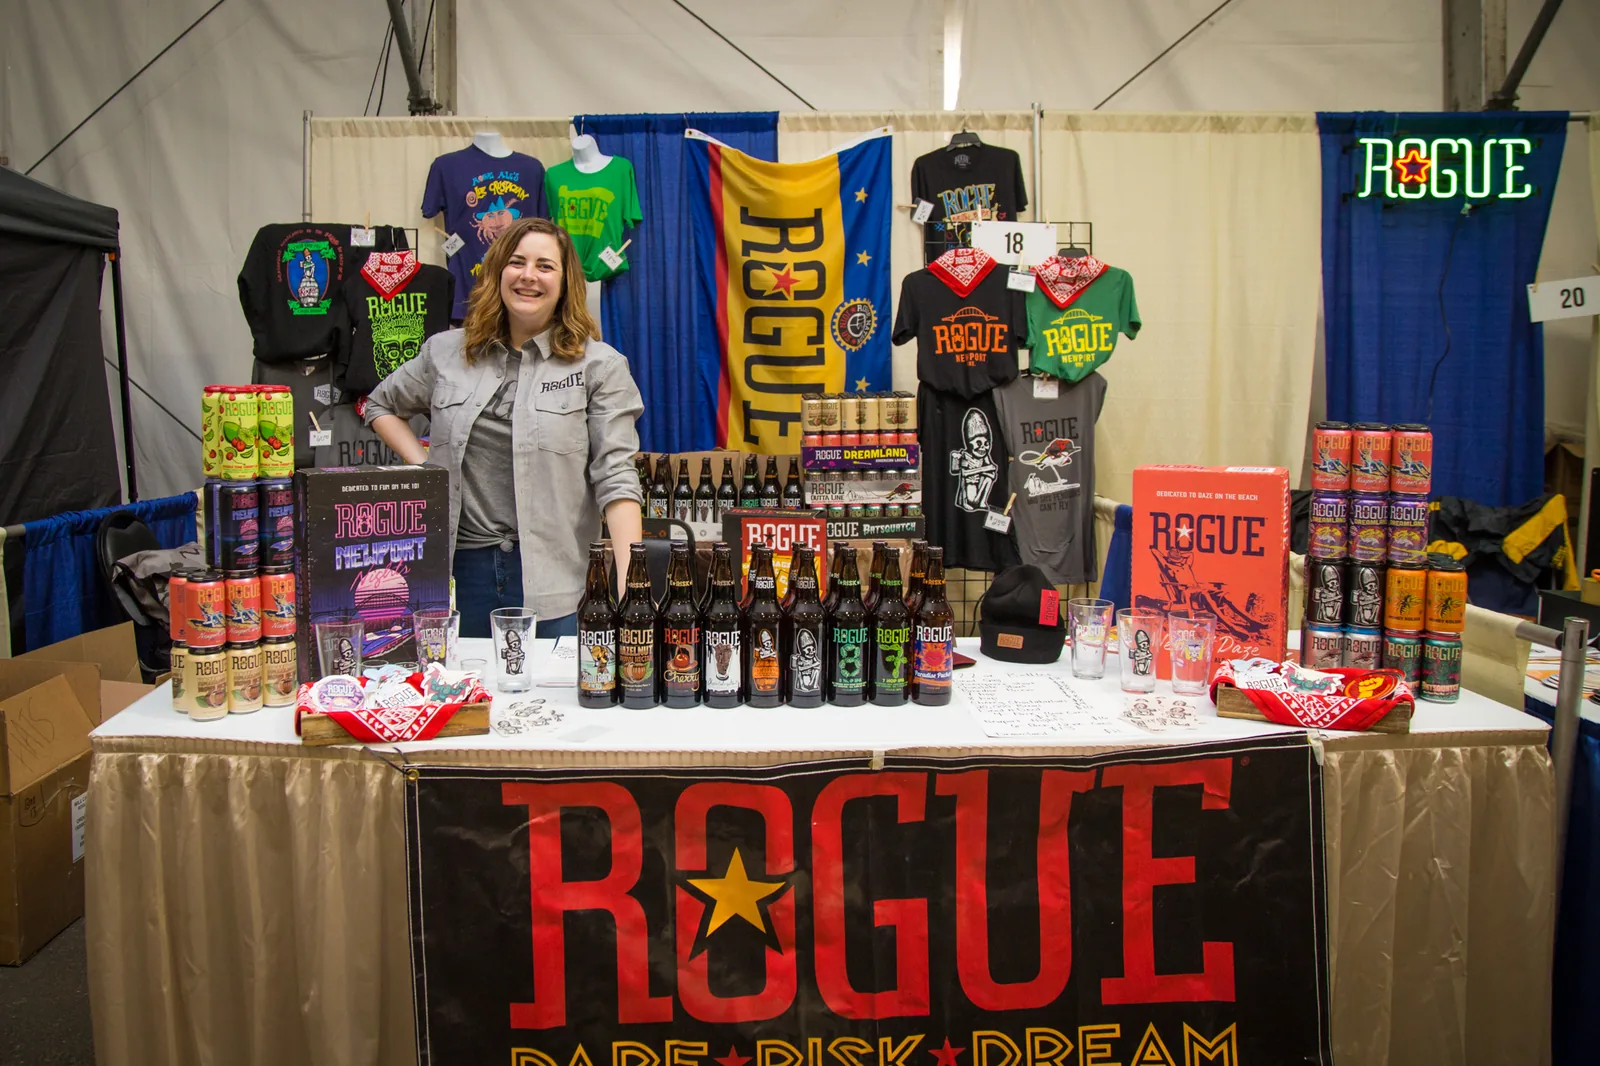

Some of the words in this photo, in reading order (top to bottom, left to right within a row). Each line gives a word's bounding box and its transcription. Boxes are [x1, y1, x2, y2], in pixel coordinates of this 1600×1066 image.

[1357, 137, 1532, 199] ROGUE
[488, 180, 529, 200] CRUSTACEAN
[1004, 232, 1024, 254] 18
[1560, 287, 1585, 308] 20
[365, 293, 428, 319] ROGUE
[740, 205, 827, 446] ROGUE
[933, 322, 1008, 354] ROGUE
[1042, 323, 1113, 356] ROGUE
[540, 371, 585, 393] ROGUE
[316, 389, 339, 400] ROGE
[225, 402, 257, 416] ROGUE
[261, 401, 292, 415] ROGUE
[1020, 417, 1079, 445] ROGUE
[1317, 435, 1350, 450] ROGUE
[1358, 435, 1391, 450] ROGUE
[1398, 437, 1432, 452] ROGUE
[815, 449, 841, 460] ROGUE
[843, 448, 907, 460] DREAMLAND
[342, 484, 369, 492] DEDICATED
[811, 482, 845, 494] ROGUE
[1156, 490, 1187, 498] DEDICATED
[1238, 493, 1258, 501] BEACH
[675, 499, 692, 507] OGUE
[717, 499, 734, 507] OGUE
[1313, 502, 1346, 517] ROGUE
[335, 500, 427, 539] ROGUE
[1355, 505, 1388, 519] ROGUE
[1390, 506, 1425, 520] ROGUE
[746, 523, 821, 552] ROGUE
[826, 522, 859, 537] OGUE
[863, 522, 916, 536] BATSQUATCH
[1149, 511, 1265, 556] ROGUE
[335, 536, 427, 571] NEWPORT
[349, 558, 412, 591] Nights
[228, 583, 261, 599] ROGUE
[756, 581, 774, 589] ROGUE
[797, 580, 816, 589] ROGUE
[580, 629, 616, 645] ROGUE
[619, 628, 653, 645] ROGUE
[664, 628, 700, 644] ROGUE
[706, 630, 741, 646] ROGUE
[833, 628, 868, 643] ROGUE
[876, 628, 910, 643] ROGUE
[917, 625, 952, 642] ROGUE
[620, 645, 653, 656] AZELNUT
[1218, 636, 1260, 659] Daze
[1345, 638, 1381, 653] ROGUE
[1388, 642, 1422, 658] ROGUE
[1425, 644, 1460, 660] ROGUE
[664, 668, 700, 691] Cherry
[1245, 678, 1282, 689] ROGUE
[328, 684, 355, 695] ROGUE
[382, 687, 417, 708] ROGUE
[501, 758, 1237, 1031] ROGUE
[972, 1021, 1238, 1066] DREAM
